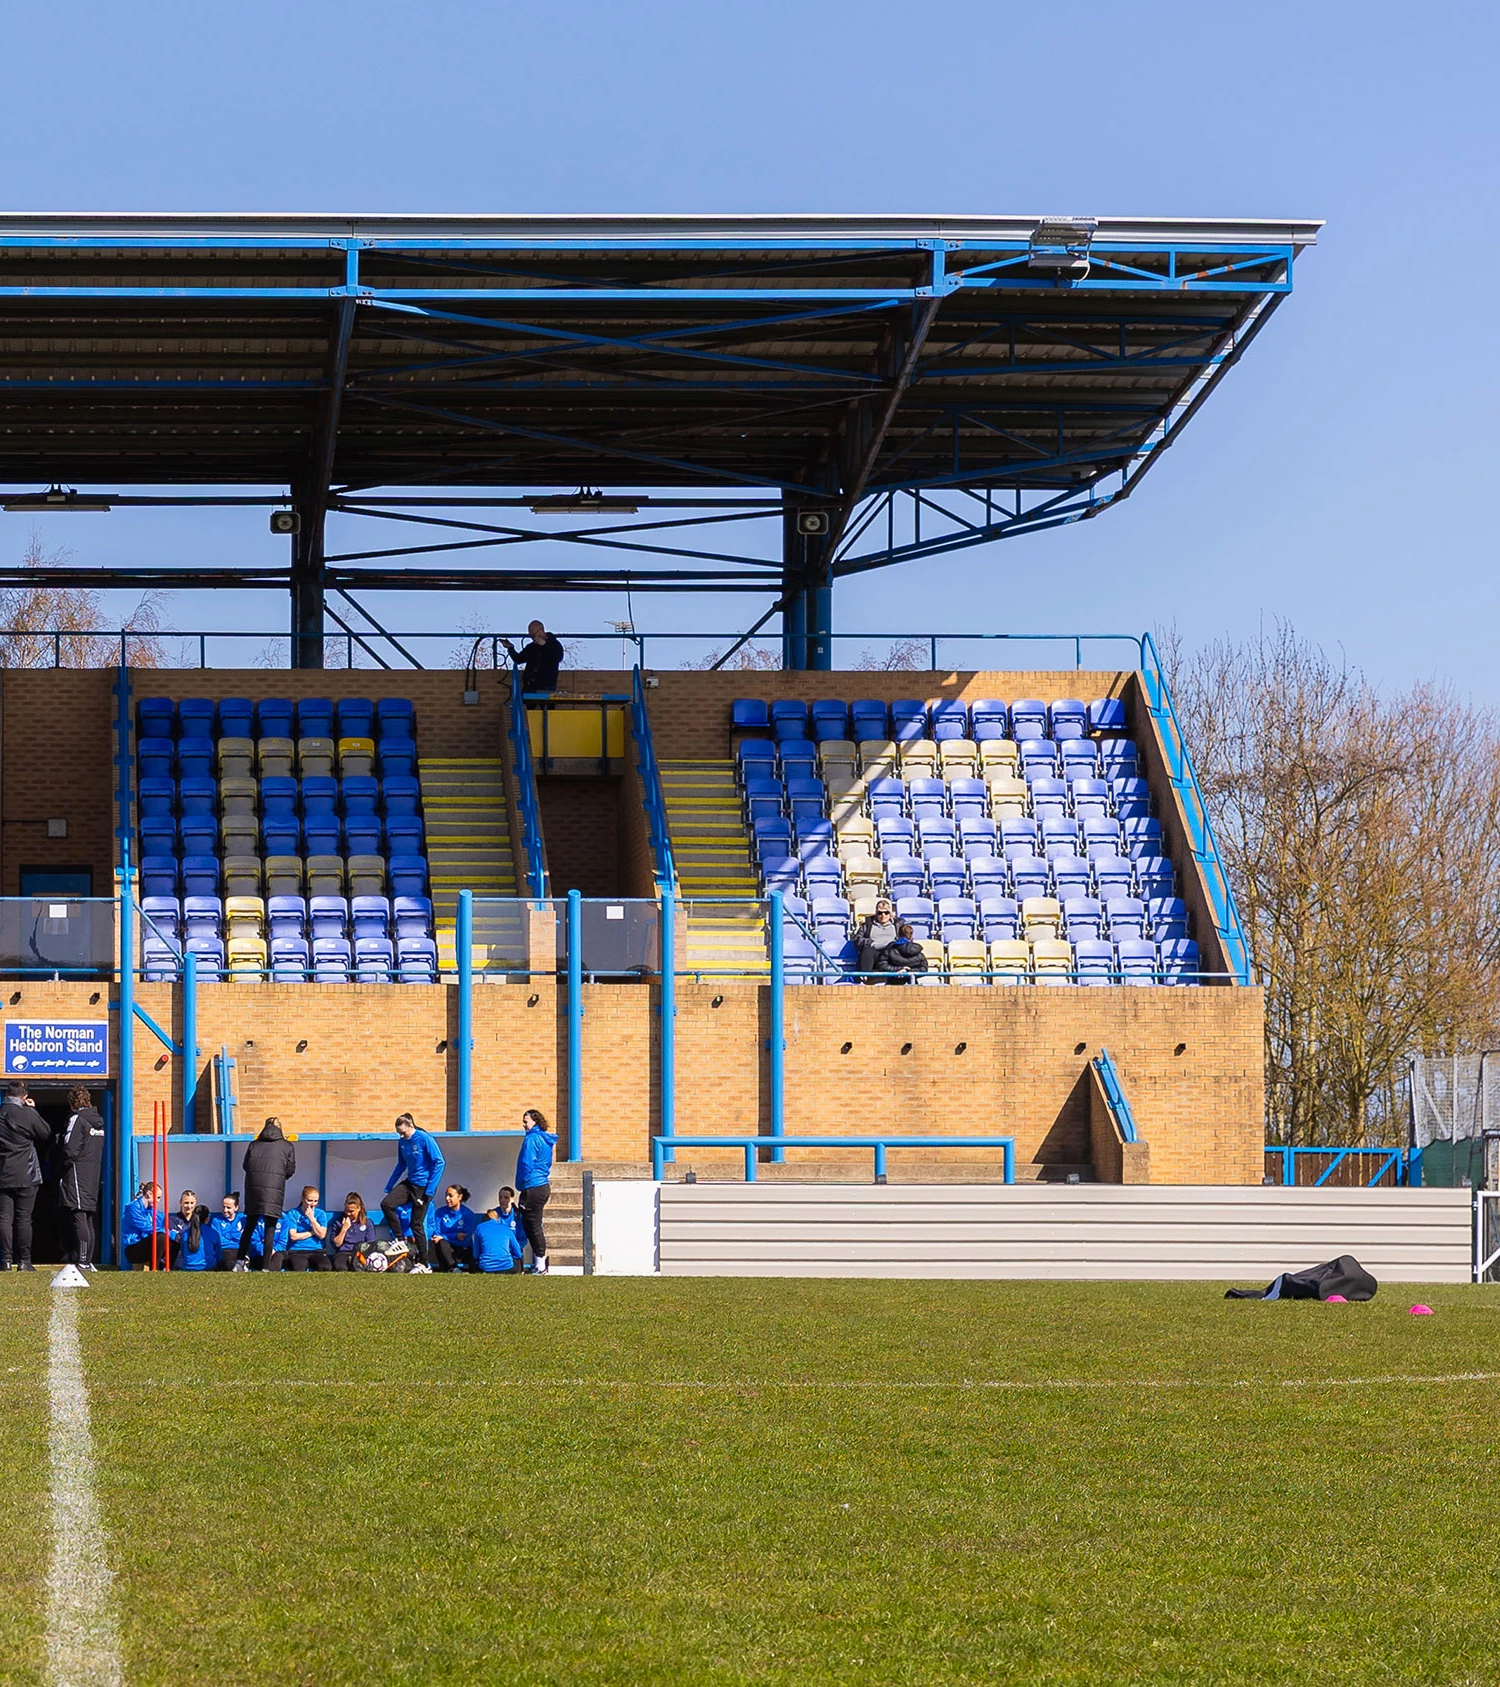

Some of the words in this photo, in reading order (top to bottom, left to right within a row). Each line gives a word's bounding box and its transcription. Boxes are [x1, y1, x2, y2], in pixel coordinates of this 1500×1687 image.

[18, 1025, 42, 1039] The
[45, 1025, 95, 1039] Norman
[9, 1039, 63, 1052] Hebbron
[66, 1039, 103, 1053] Stand
